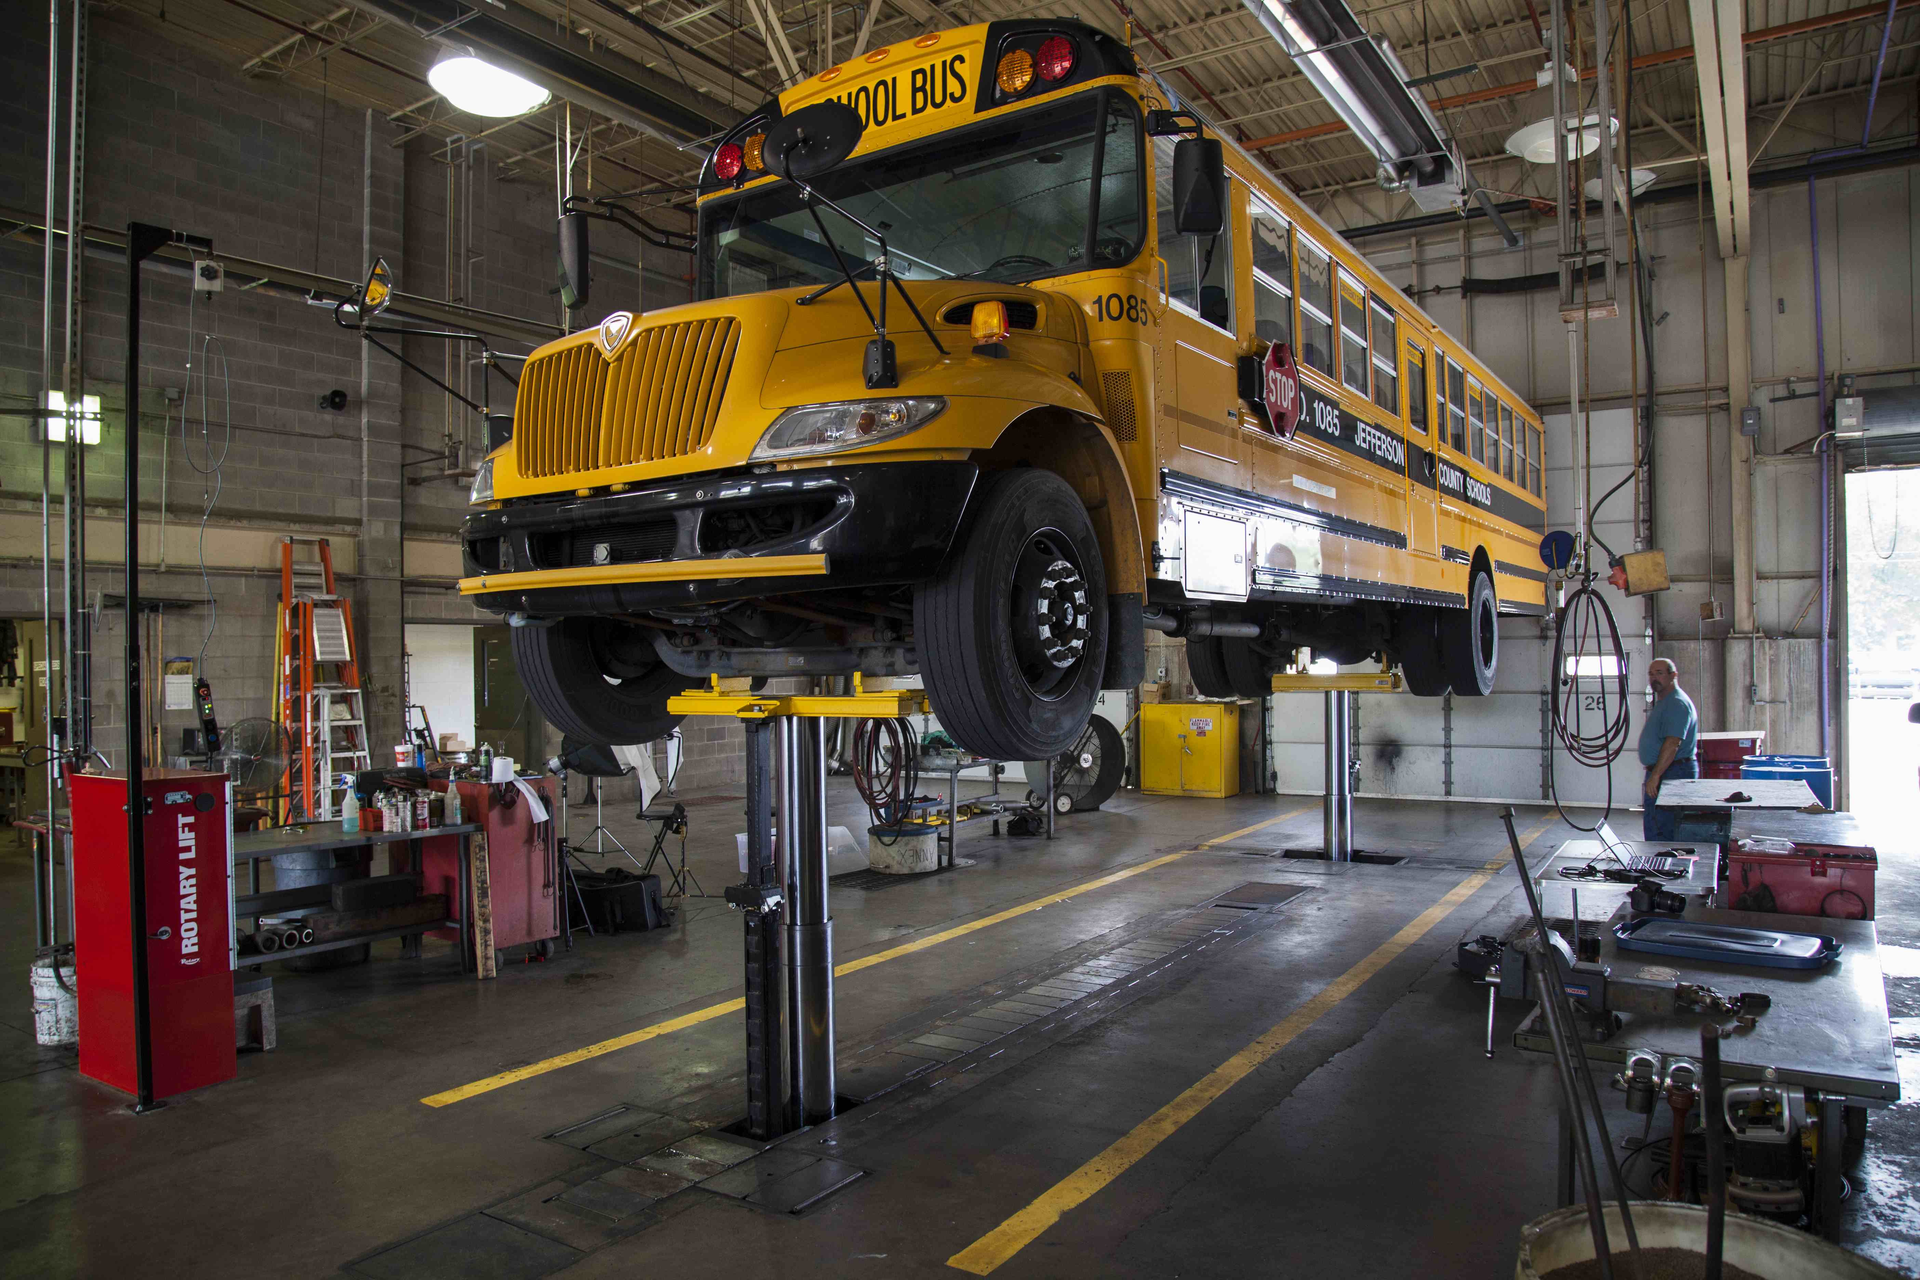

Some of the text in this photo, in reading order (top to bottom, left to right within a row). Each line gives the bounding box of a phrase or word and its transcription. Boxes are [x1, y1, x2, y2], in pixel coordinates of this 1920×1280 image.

[824, 54, 967, 132] OOL BUS
[1092, 293, 1148, 327] 1085
[1268, 369, 1295, 410] STOP
[1313, 400, 1340, 437] 1085
[1354, 420, 1405, 467] JEFFERSON
[1438, 462, 1465, 494] COUNTY
[1466, 476, 1491, 506] SCHOOLS
[177, 813, 199, 955] ROTARY LIFT
